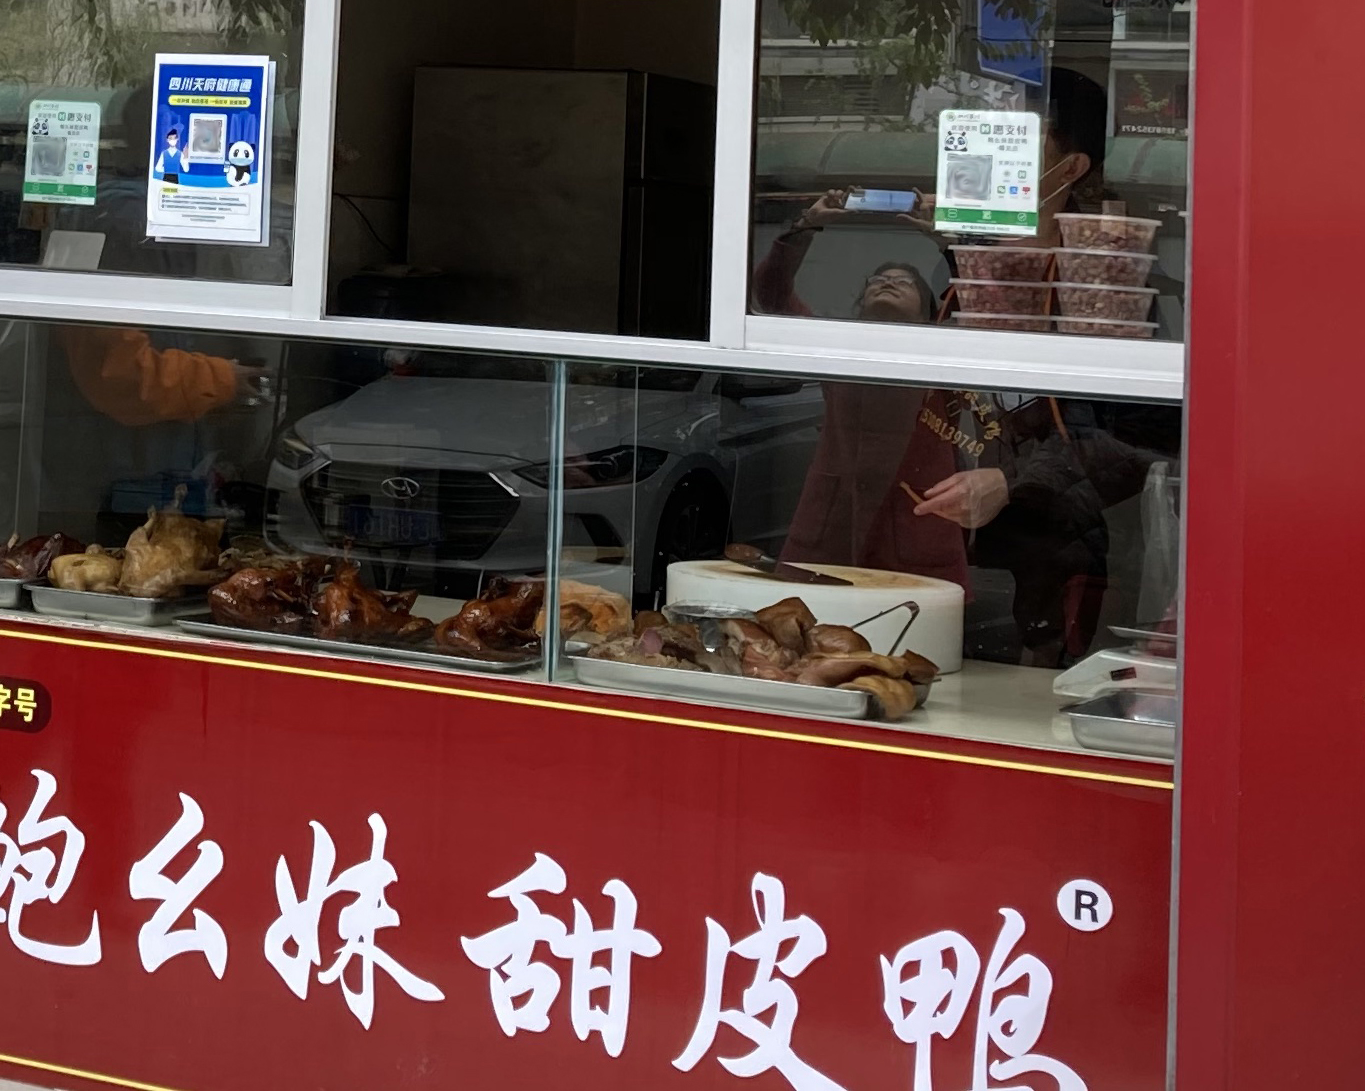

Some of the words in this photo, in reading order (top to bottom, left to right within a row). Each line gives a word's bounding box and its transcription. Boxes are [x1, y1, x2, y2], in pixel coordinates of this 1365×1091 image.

[168, 76, 253, 93] 四川天府健康通
